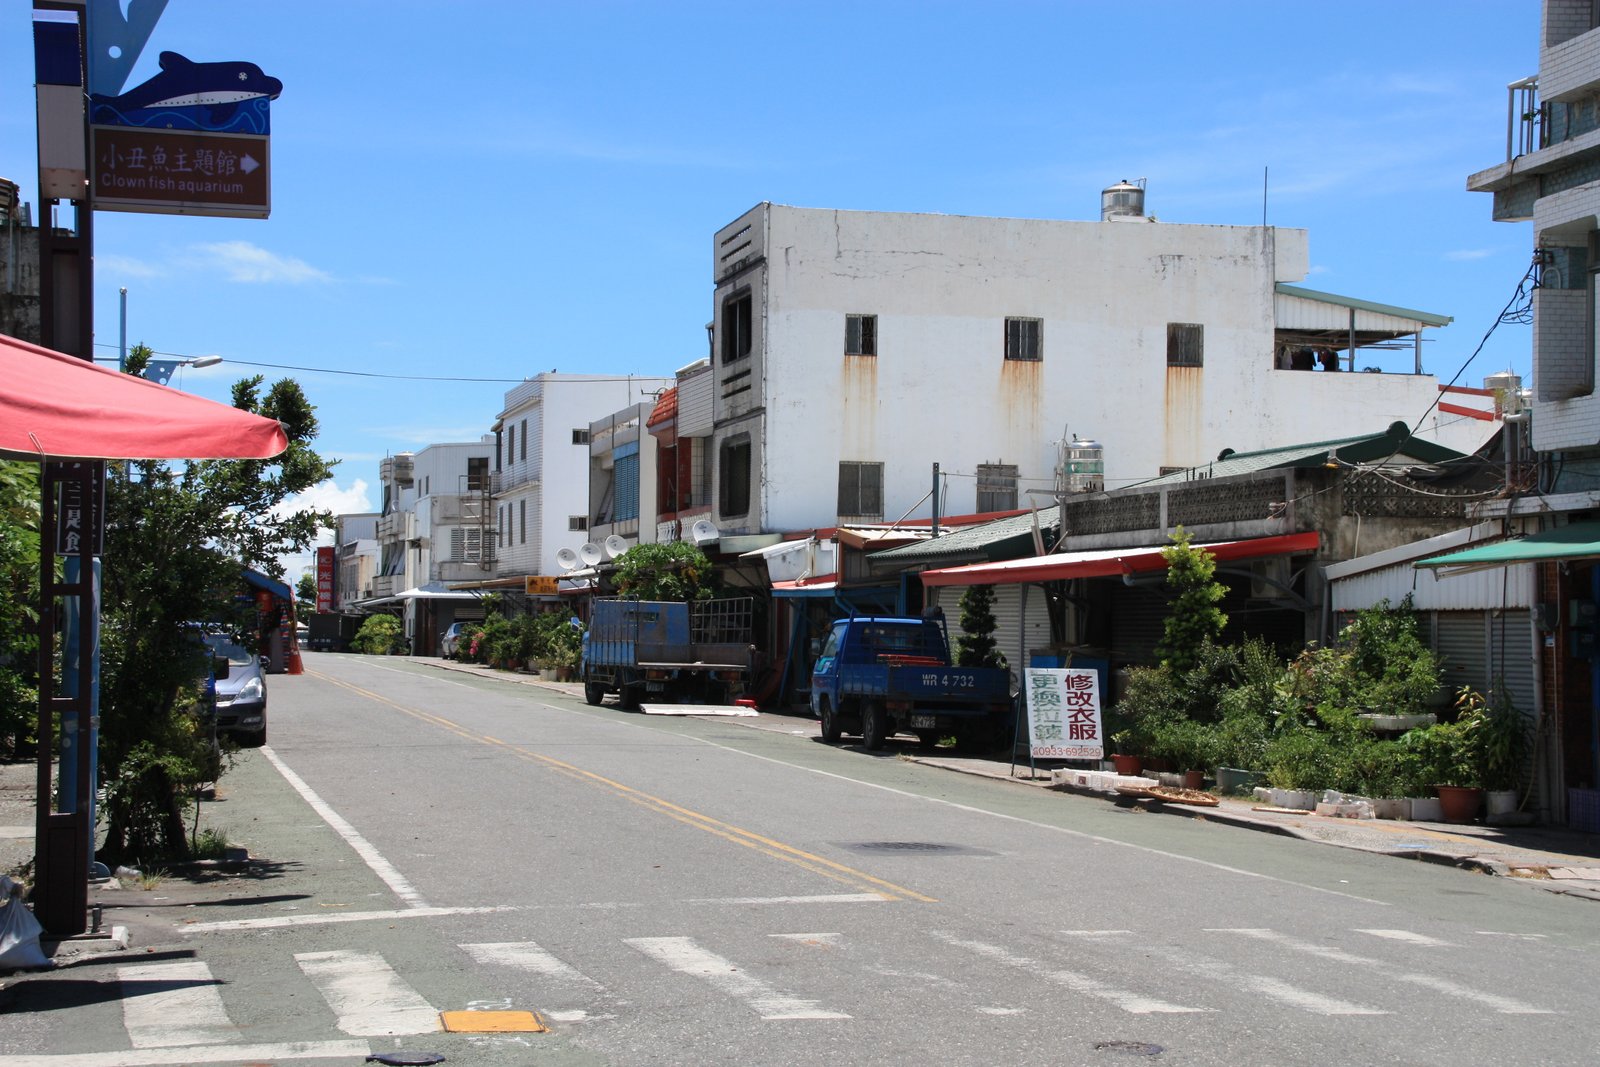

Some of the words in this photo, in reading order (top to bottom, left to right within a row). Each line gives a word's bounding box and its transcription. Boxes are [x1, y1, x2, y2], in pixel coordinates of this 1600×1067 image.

[102, 143, 237, 176] 小丑魚主題館
[102, 173, 146, 188] Clown
[149, 176, 175, 190] fish
[178, 179, 244, 193] aquarium
[1064, 674, 1098, 740] 修改衣服
